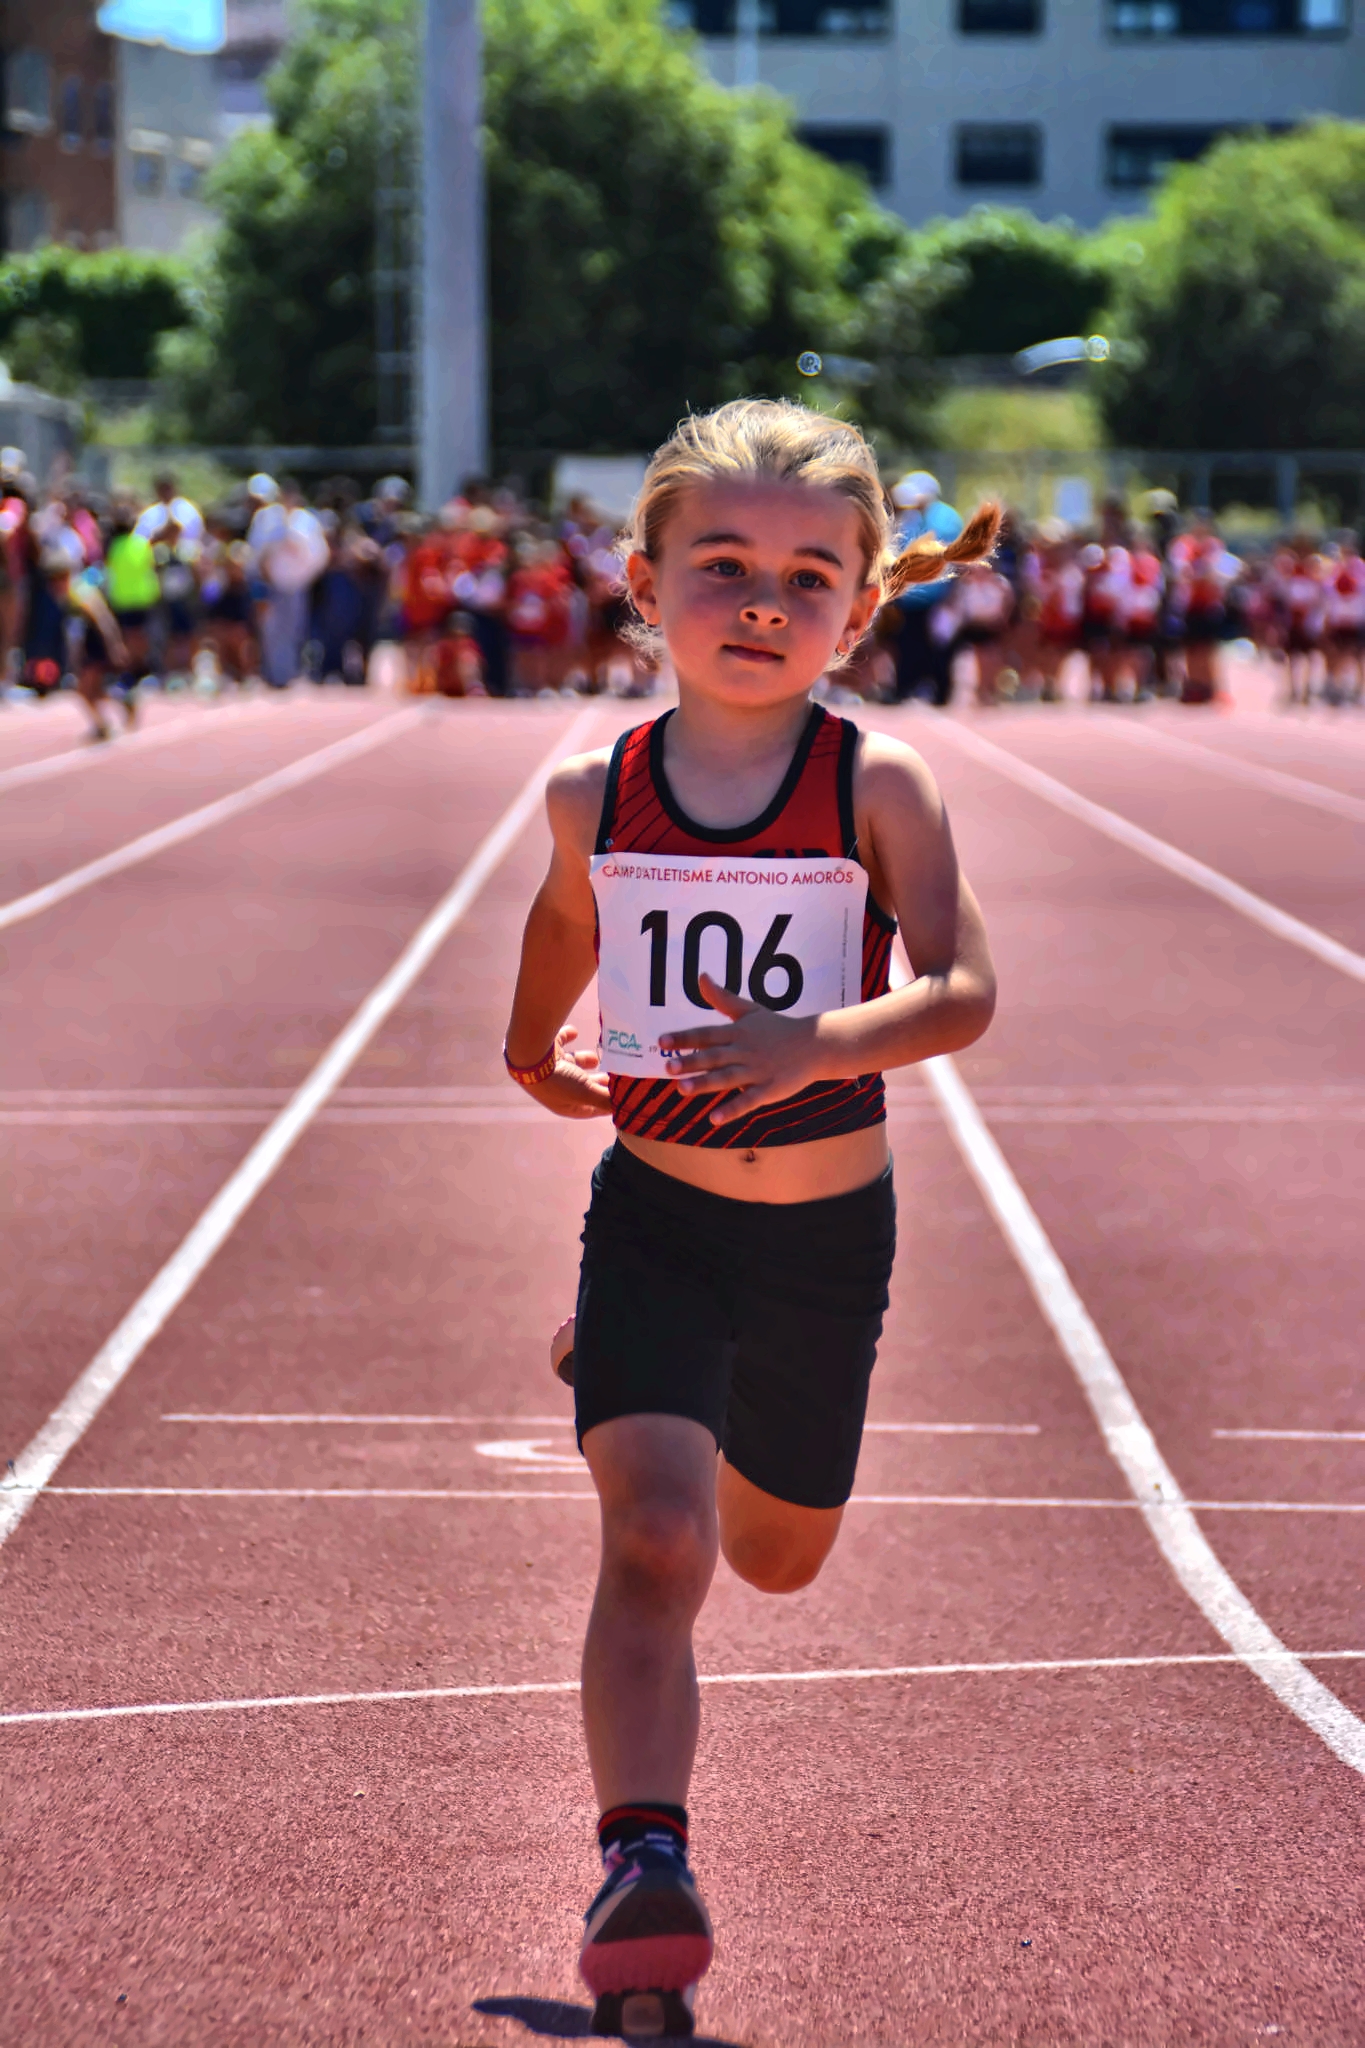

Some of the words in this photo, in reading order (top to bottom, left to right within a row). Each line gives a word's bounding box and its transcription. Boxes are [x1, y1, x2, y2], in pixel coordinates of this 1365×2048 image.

[602, 865, 635, 879] CAMP
[716, 870, 788, 885] ANTONIO
[640, 909, 804, 1011] 106
